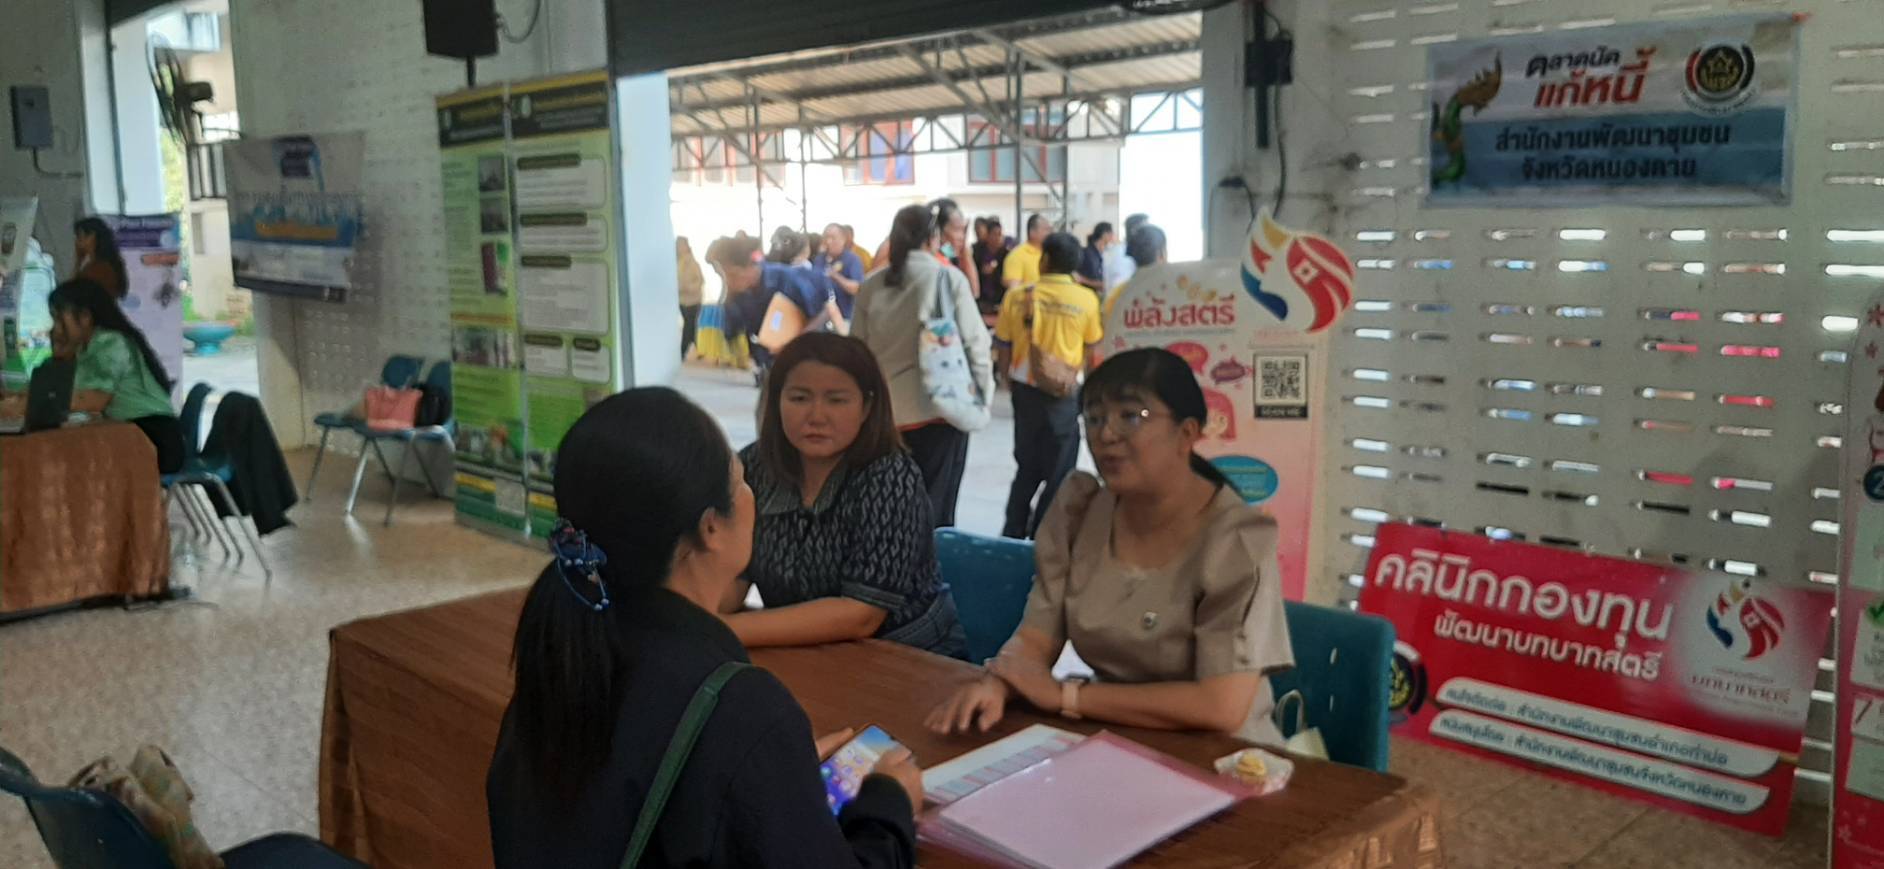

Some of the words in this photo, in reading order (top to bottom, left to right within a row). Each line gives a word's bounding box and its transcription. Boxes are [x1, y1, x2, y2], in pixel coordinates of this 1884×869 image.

[1525, 47, 1620, 78] ตลาดนัด
[1534, 46, 1657, 108] แก้หนี้
[1495, 124, 1731, 154] สำนักงานพัฒนาชุมชน
[1522, 157, 1696, 181] จังหวัดหนองคาย
[1375, 548, 1674, 648] คลินิกกองทุน
[1434, 610, 1664, 681] พัฒนาบทบาทสตรี
